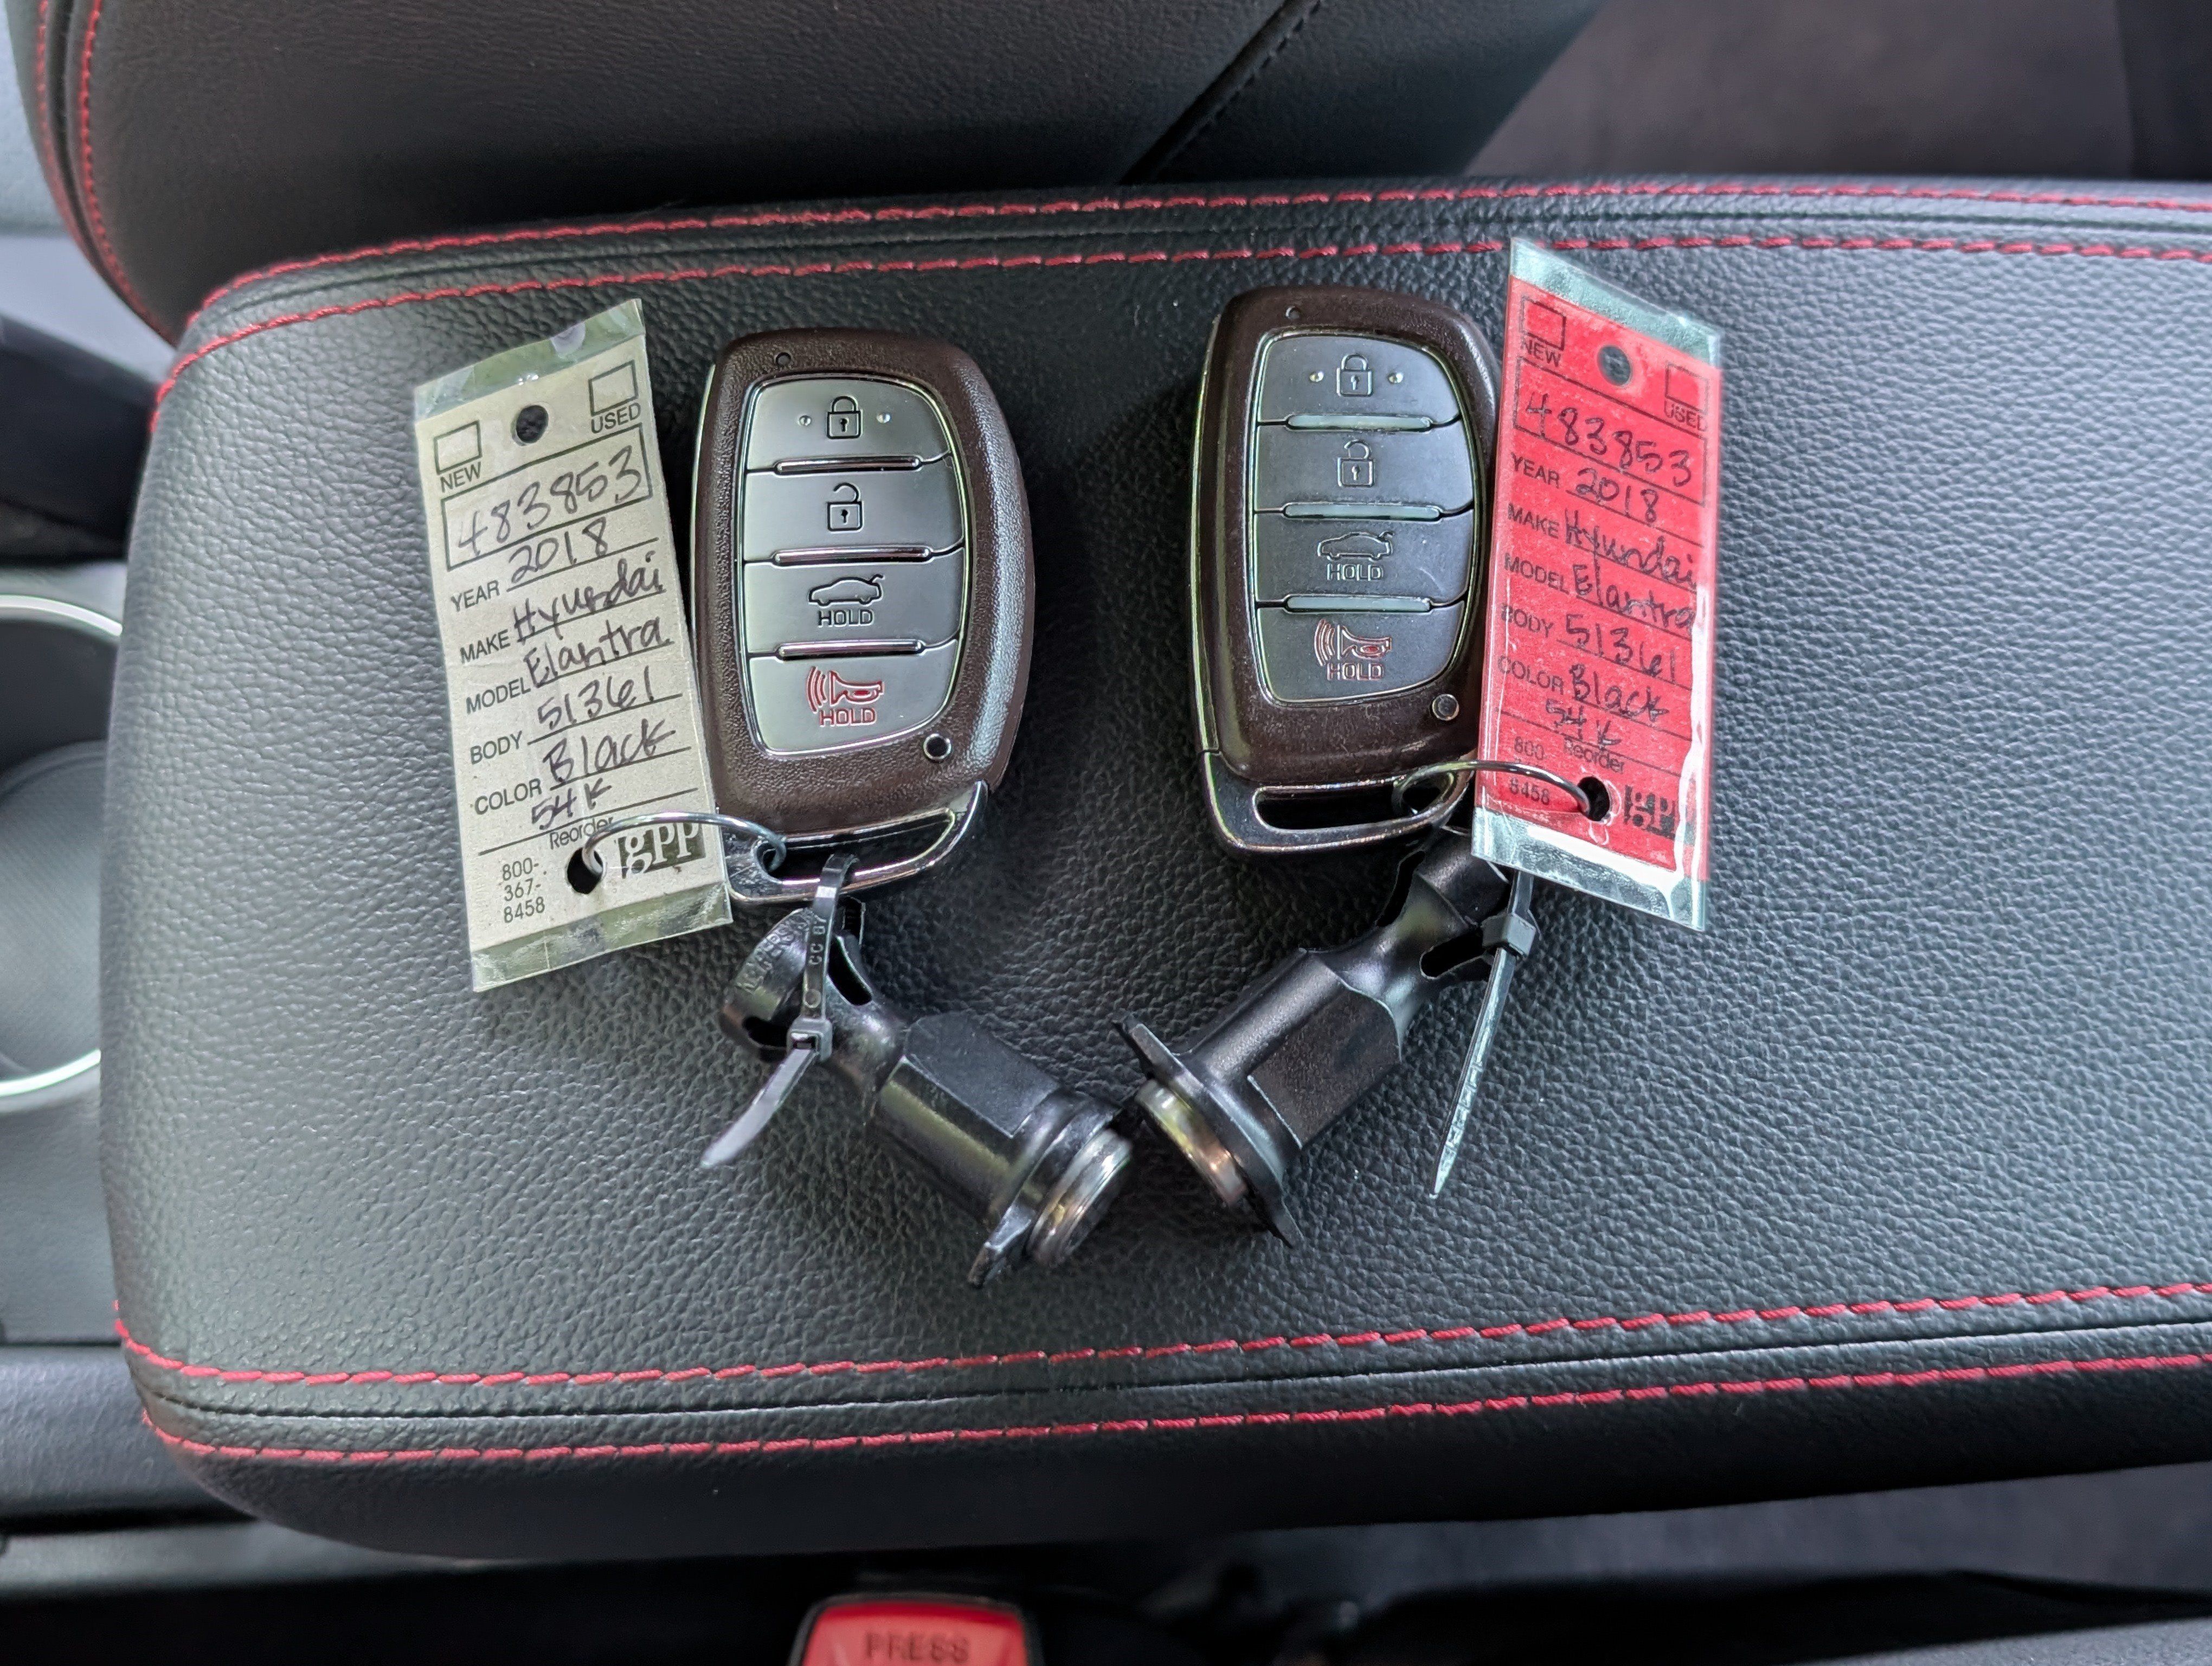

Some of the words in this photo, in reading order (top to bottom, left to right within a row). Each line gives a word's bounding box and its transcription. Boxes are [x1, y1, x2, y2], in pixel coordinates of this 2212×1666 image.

[1520, 340, 1563, 368] NEW
[590, 401, 641, 434] USED
[1664, 400, 1708, 432] USED
[1526, 392, 1692, 487] 483853
[440, 462, 483, 492] NEW
[1510, 451, 1560, 489] YEAR
[458, 445, 642, 558] 483853
[1576, 467, 1659, 524] 2018
[1507, 503, 1560, 537] MAKE
[509, 517, 609, 584] 2018
[1564, 507, 1697, 592] Hyundai
[1326, 563, 1384, 581] HOLD
[1504, 552, 1570, 595] MODEL
[450, 580, 501, 612] YEAR
[818, 610, 873, 627] HOLD
[1501, 601, 1554, 638] BODY
[459, 630, 510, 664] MAKE
[525, 617, 672, 688] Elantra
[1566, 613, 1676, 684] 51361
[1326, 663, 1385, 681] HOLD
[1497, 655, 1565, 696] COLOR
[466, 677, 531, 714] MODEL
[538, 666, 655, 730] 51361
[1570, 664, 1669, 723] Black
[819, 708, 877, 727] HOLD
[470, 731, 523, 765] BODY
[542, 717, 676, 782] Black
[1564, 736, 1625, 774] Reorder
[473, 780, 543, 815] COLOR
[1509, 778, 1550, 806] 8458
[549, 816, 614, 850] Reorder
[501, 857, 540, 881] 800-
[504, 881, 542, 903] 367-
[504, 896, 545, 924] 8458
[808, 942, 824, 966] CC
[864, 1630, 970, 1664] PRESS
